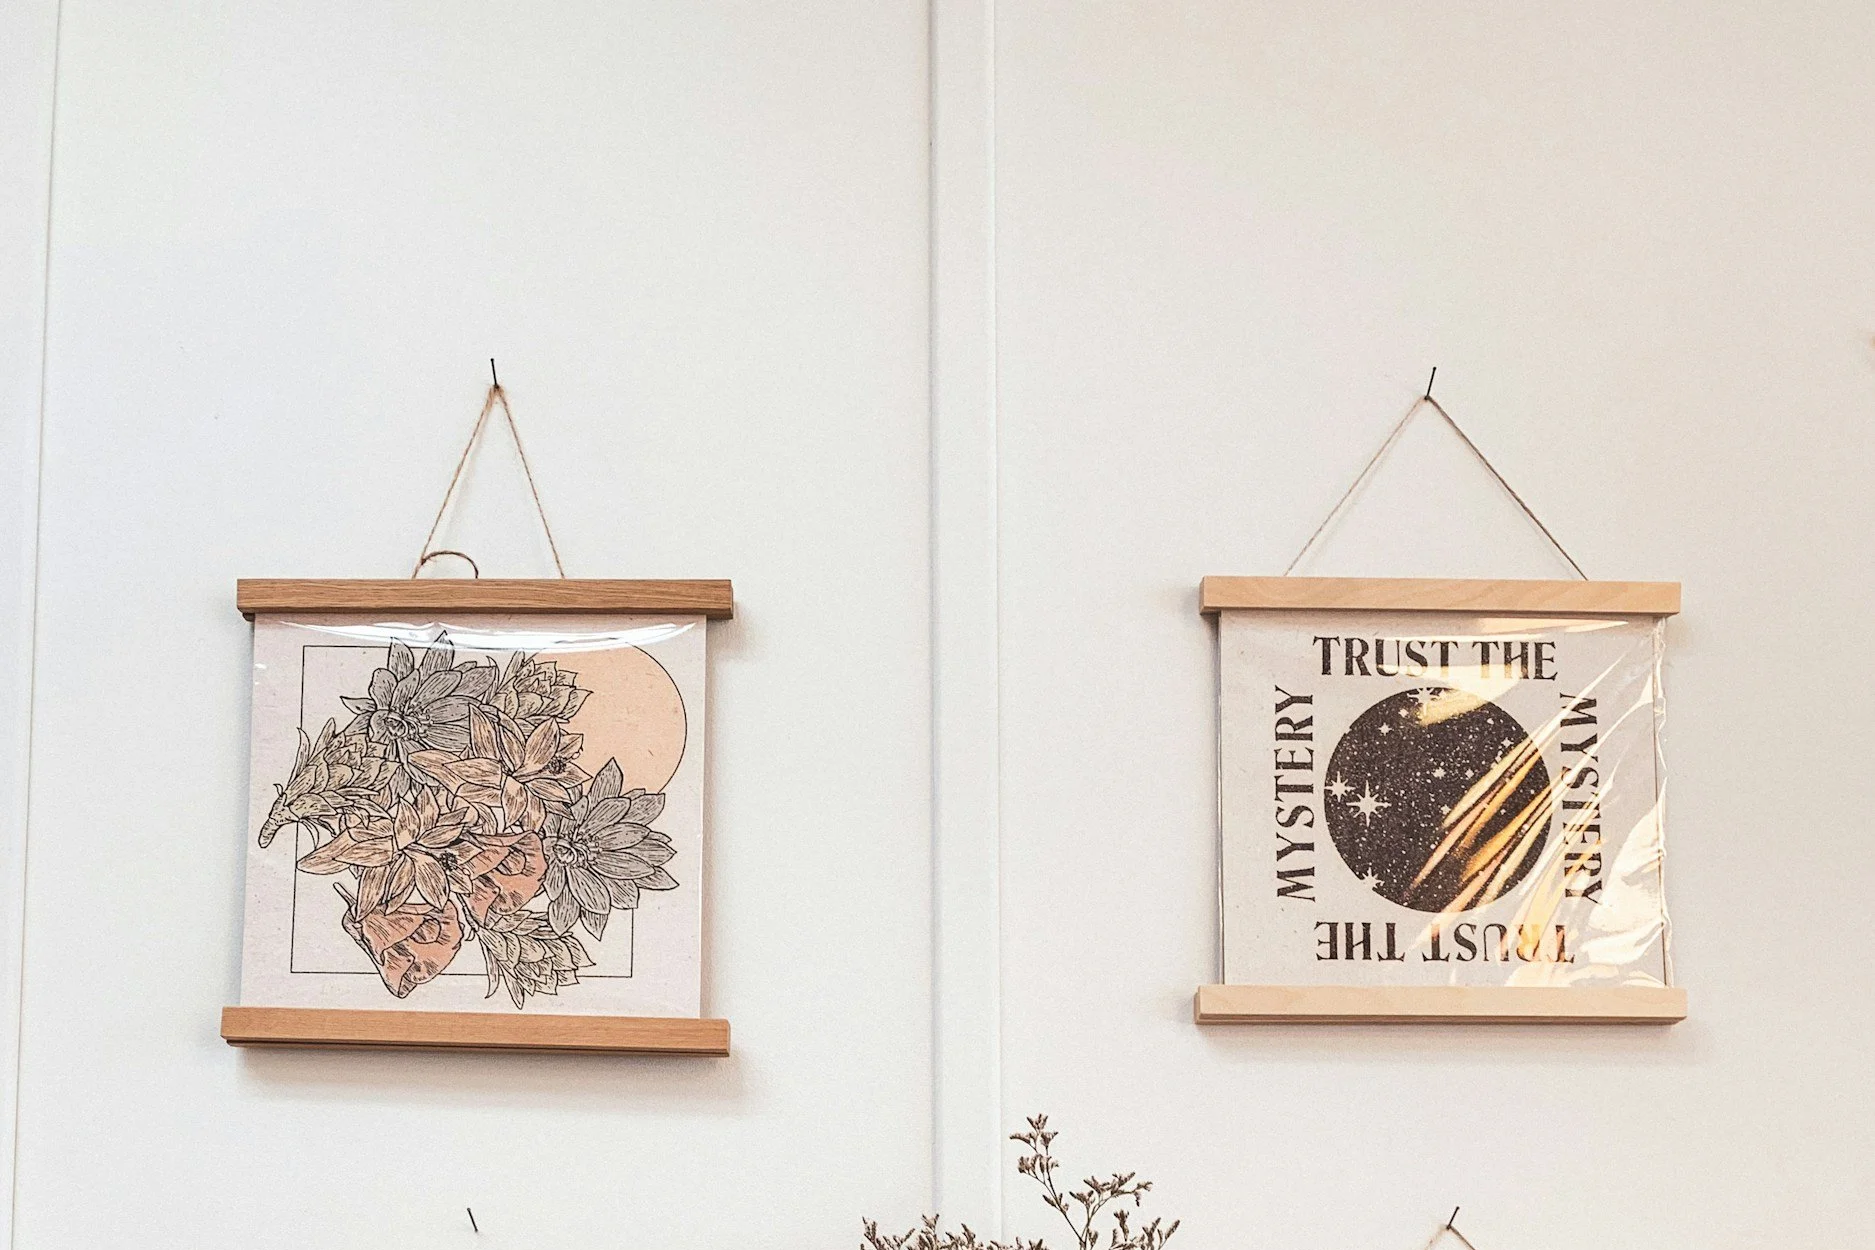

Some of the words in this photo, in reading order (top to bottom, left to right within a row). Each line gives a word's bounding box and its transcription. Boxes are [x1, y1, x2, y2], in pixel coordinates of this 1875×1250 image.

[1312, 635, 1459, 678] TRUST
[1472, 640, 1558, 681] THE
[1274, 684, 1316, 903] MYSTERY
[1559, 692, 1603, 905] MYSTERY
[1314, 921, 1406, 962] THE
